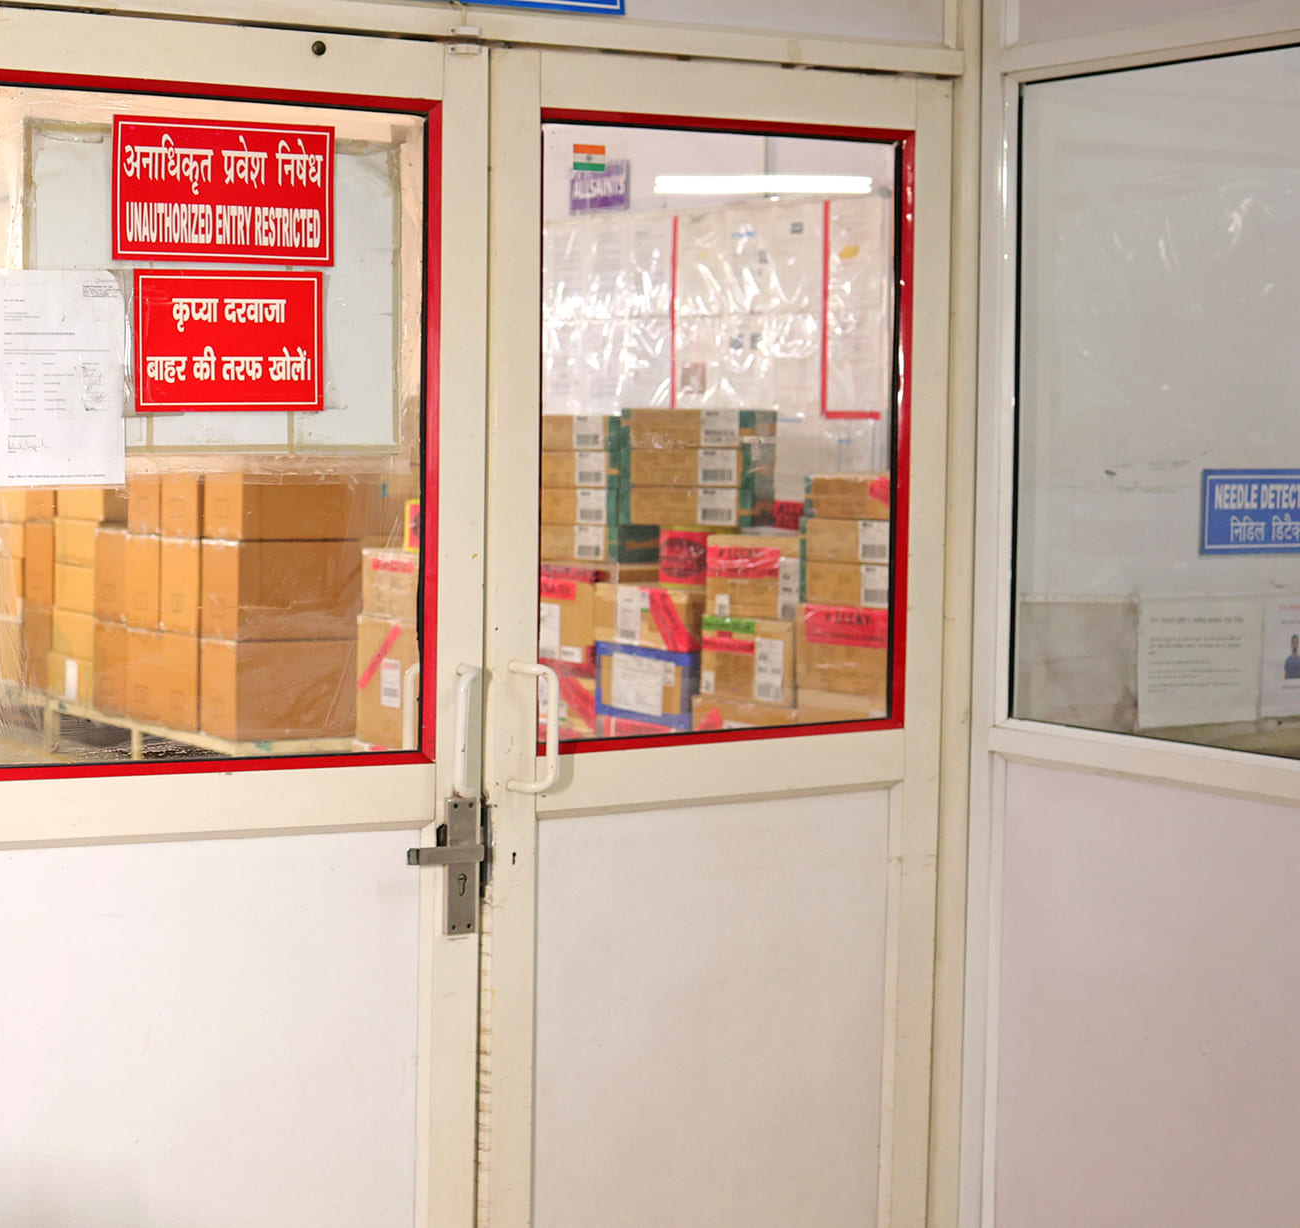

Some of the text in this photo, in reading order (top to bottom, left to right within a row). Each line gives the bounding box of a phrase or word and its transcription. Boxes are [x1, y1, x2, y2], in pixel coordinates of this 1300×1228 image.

[123, 133, 324, 195] अनाधिकृत प्रवेश निषेध
[125, 201, 321, 248] UNAUTHORIZED ENTRY RESTRICTED
[172, 297, 287, 332] कृप्या दरवाजा
[146, 356, 187, 384] बाहर
[192, 346, 216, 382] की
[221, 356, 263, 381] तरफ
[1214, 484, 1259, 510] NEEDLE
